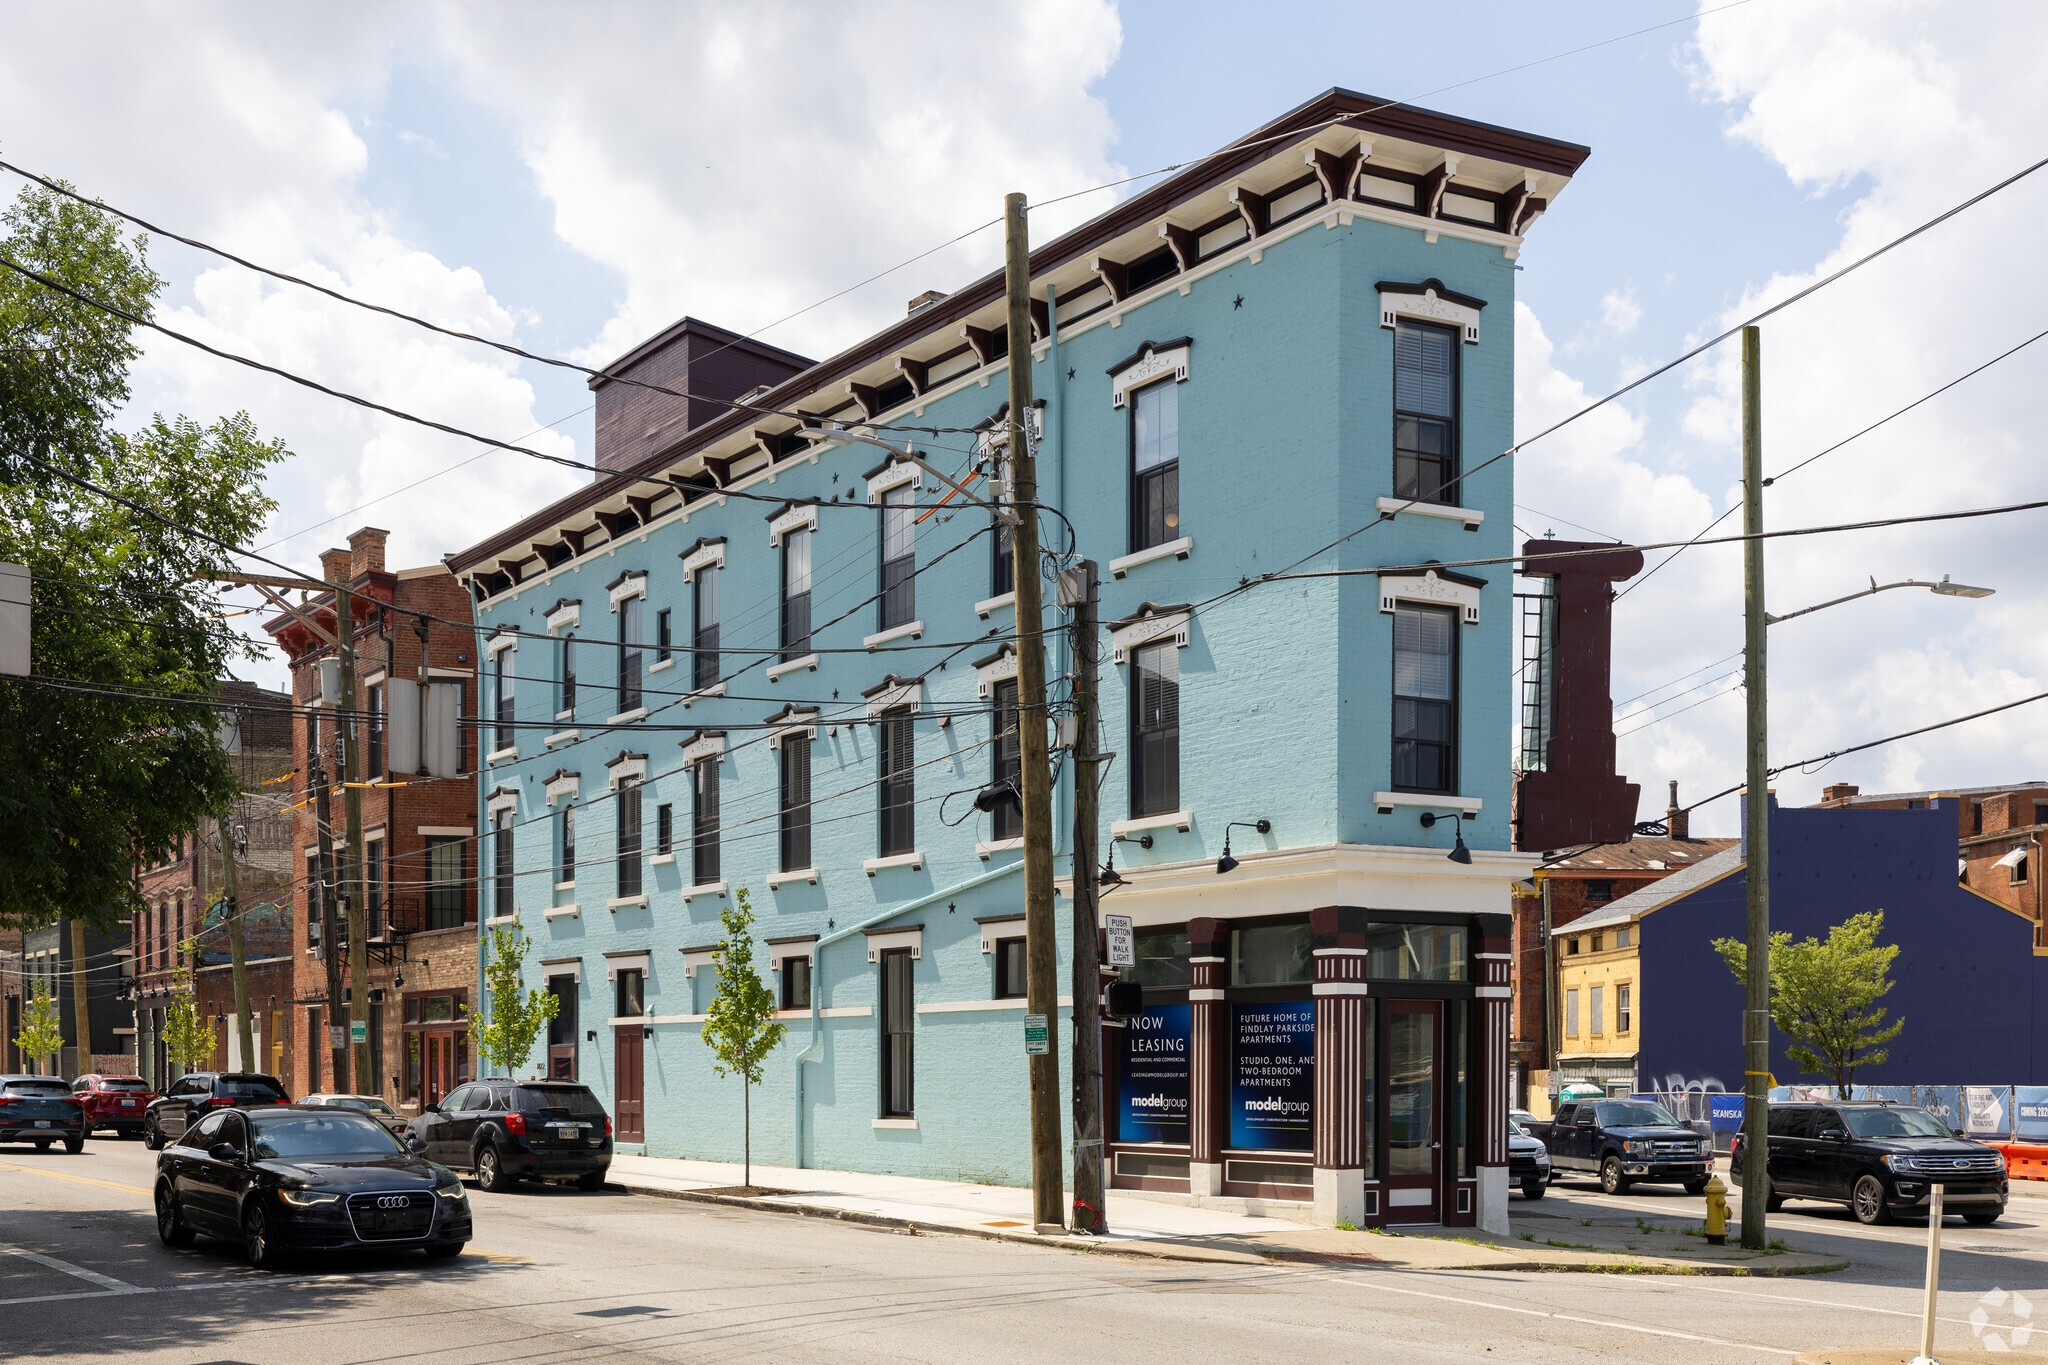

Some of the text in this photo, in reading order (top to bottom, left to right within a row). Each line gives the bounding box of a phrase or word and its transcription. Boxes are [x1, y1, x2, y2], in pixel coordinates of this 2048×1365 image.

[1112, 918, 1128, 927] PUSH
[1109, 928, 1131, 936] BUTTON
[1113, 954, 1129, 962] LIGHT
[1240, 1013, 1312, 1023] FUTURE HOME OF
[1132, 1017, 1164, 1030] NOW
[1240, 1024, 1315, 1033] FINDLAY PARKSIDE
[1240, 1035, 1291, 1044] APARTMENTS
[1131, 1038, 1184, 1052] LEASING
[1298, 1056, 1315, 1064] AND
[1240, 1067, 1302, 1075] TWO-BEDROOM
[1240, 1078, 1291, 1087] APARTMENTS
[1132, 1093, 1187, 1110] modelgroup
[1245, 1096, 1309, 1115] modelgroup
[1713, 1109, 1742, 1119] SKANSKA
[2021, 1106, 2048, 1117] COMING 202
